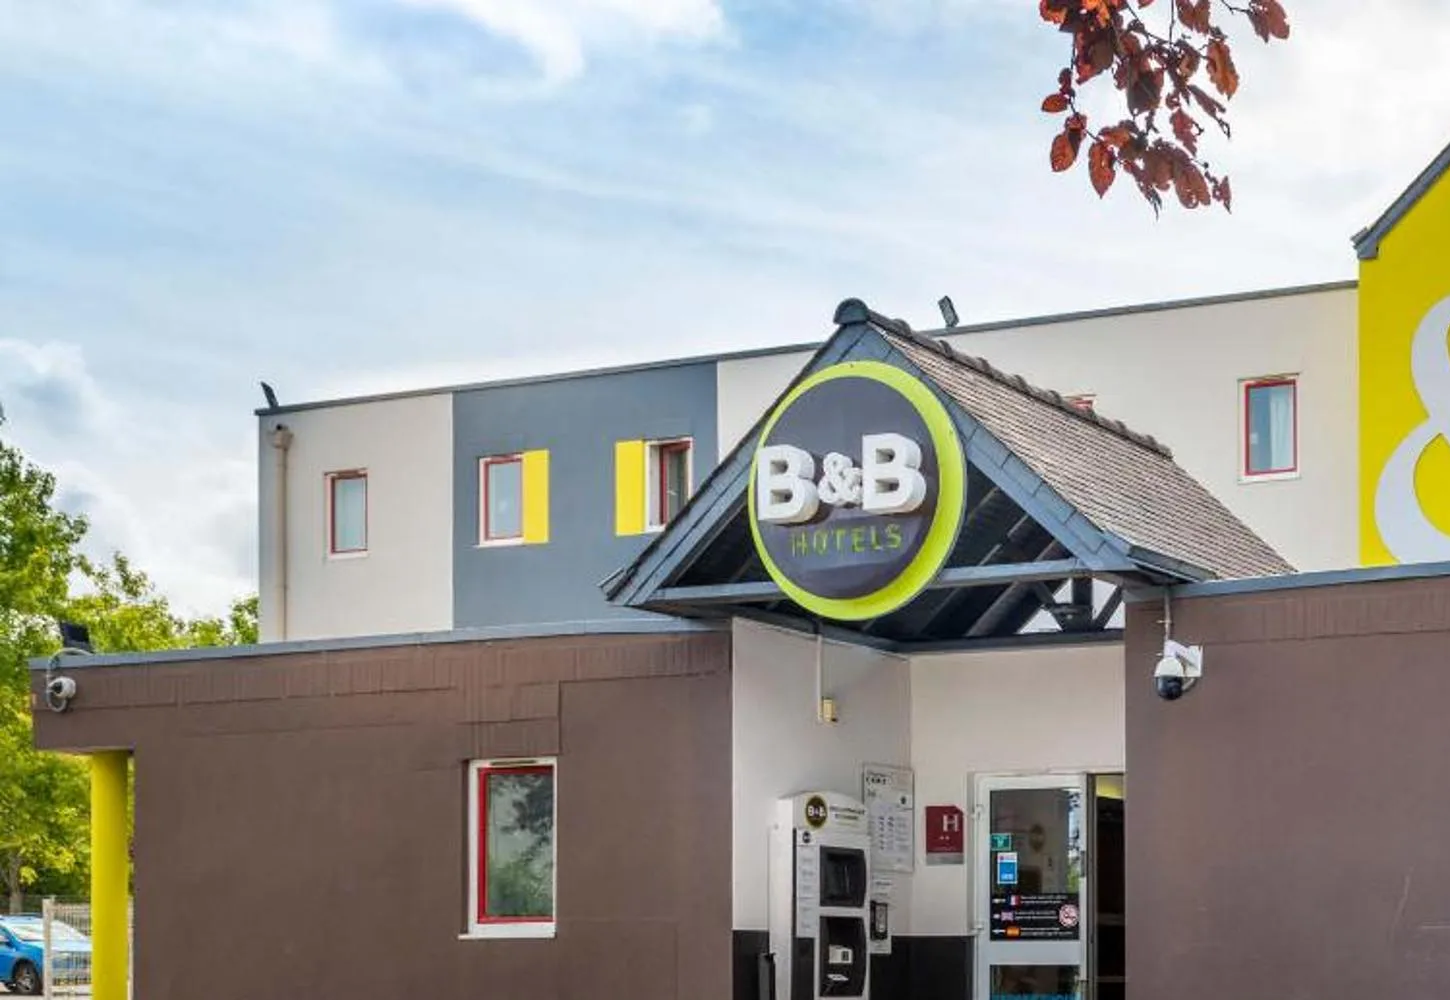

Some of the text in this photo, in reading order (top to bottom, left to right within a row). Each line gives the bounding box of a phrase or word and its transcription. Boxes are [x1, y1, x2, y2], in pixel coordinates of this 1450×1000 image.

[757, 433, 927, 524] B&B
[791, 524, 902, 558] HOTELS
[943, 814, 960, 833] H
